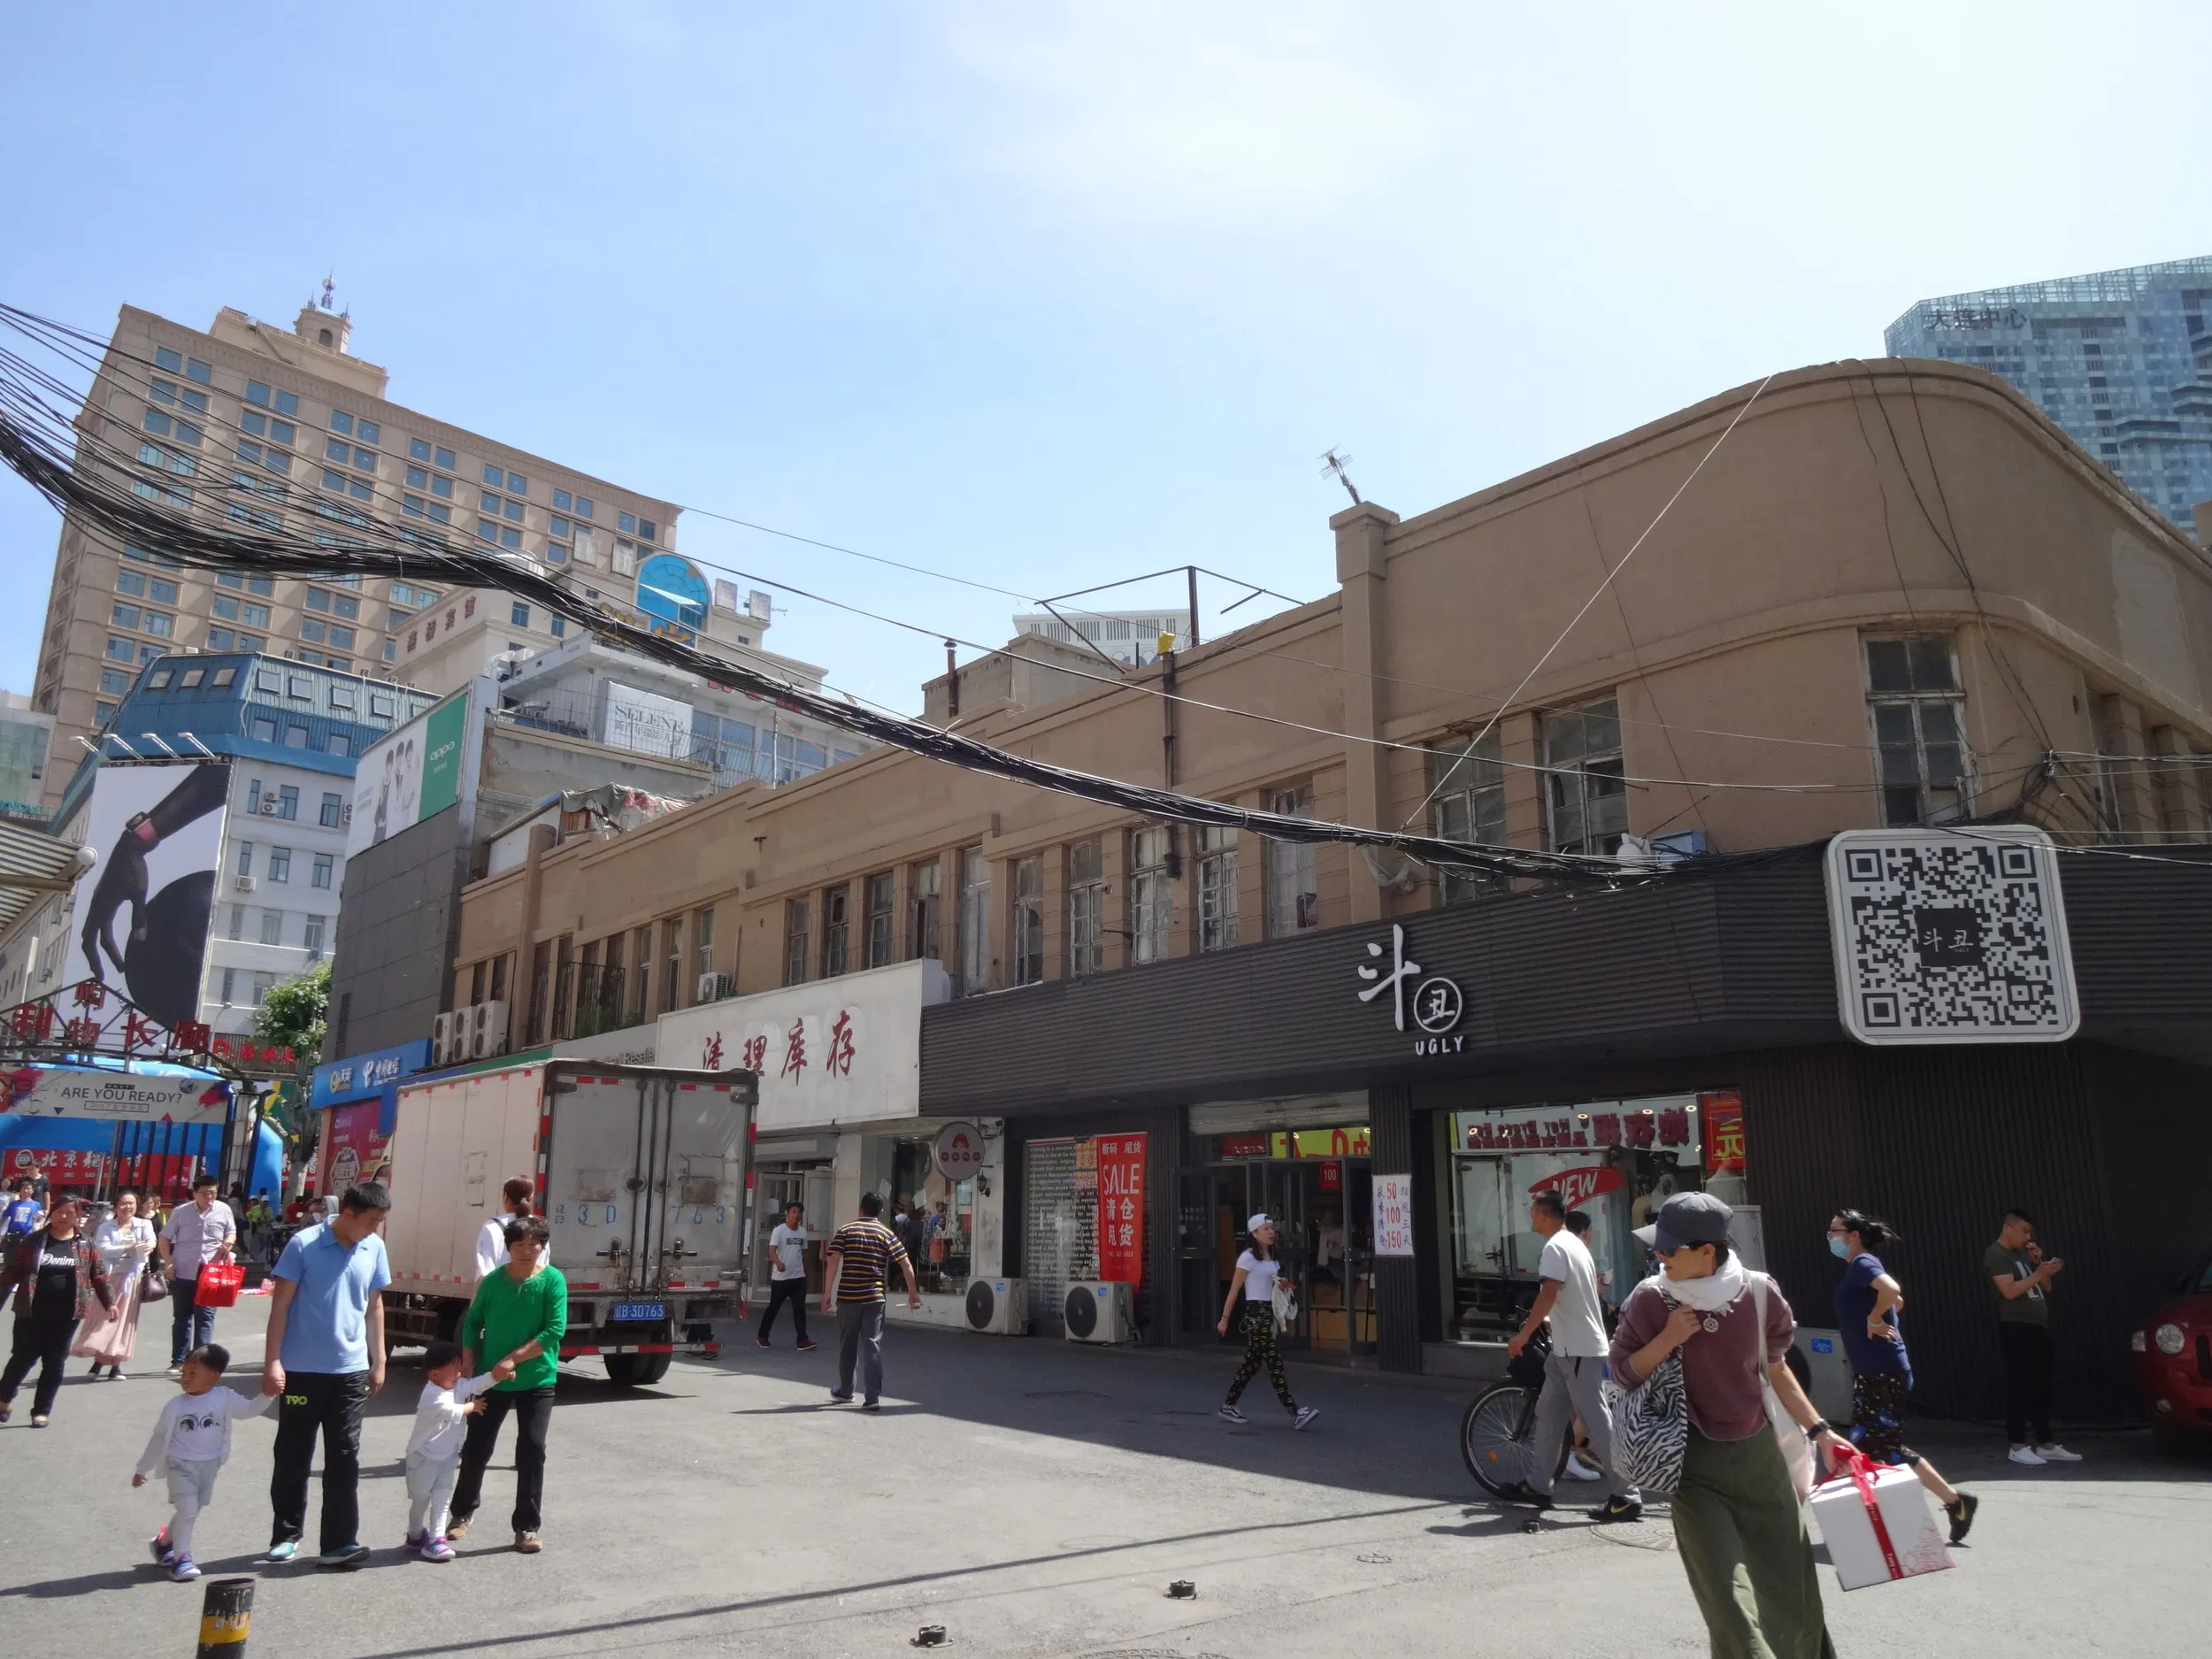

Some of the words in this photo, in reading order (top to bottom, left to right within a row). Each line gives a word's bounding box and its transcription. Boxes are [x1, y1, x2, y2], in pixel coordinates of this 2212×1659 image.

[1923, 307, 2027, 329] 大连中心
[703, 1010, 856, 1087] 清理库存
[1416, 1035, 1463, 1056] UGLY
[61, 1087, 89, 1099] ARE
[95, 1089, 125, 1101] YOU
[128, 1090, 182, 1103] READY?
[1102, 1164, 1141, 1195] SALE
[1324, 1168, 1337, 1180] 100
[1386, 1182, 1397, 1200] 50
[1552, 1171, 1599, 1206] NEW
[1106, 1196, 1135, 1221] 清仓
[1386, 1206, 1401, 1224] 100
[1108, 1224, 1134, 1247] 甩货
[1386, 1231, 1402, 1248] 150
[285, 1394, 308, 1406] T90
